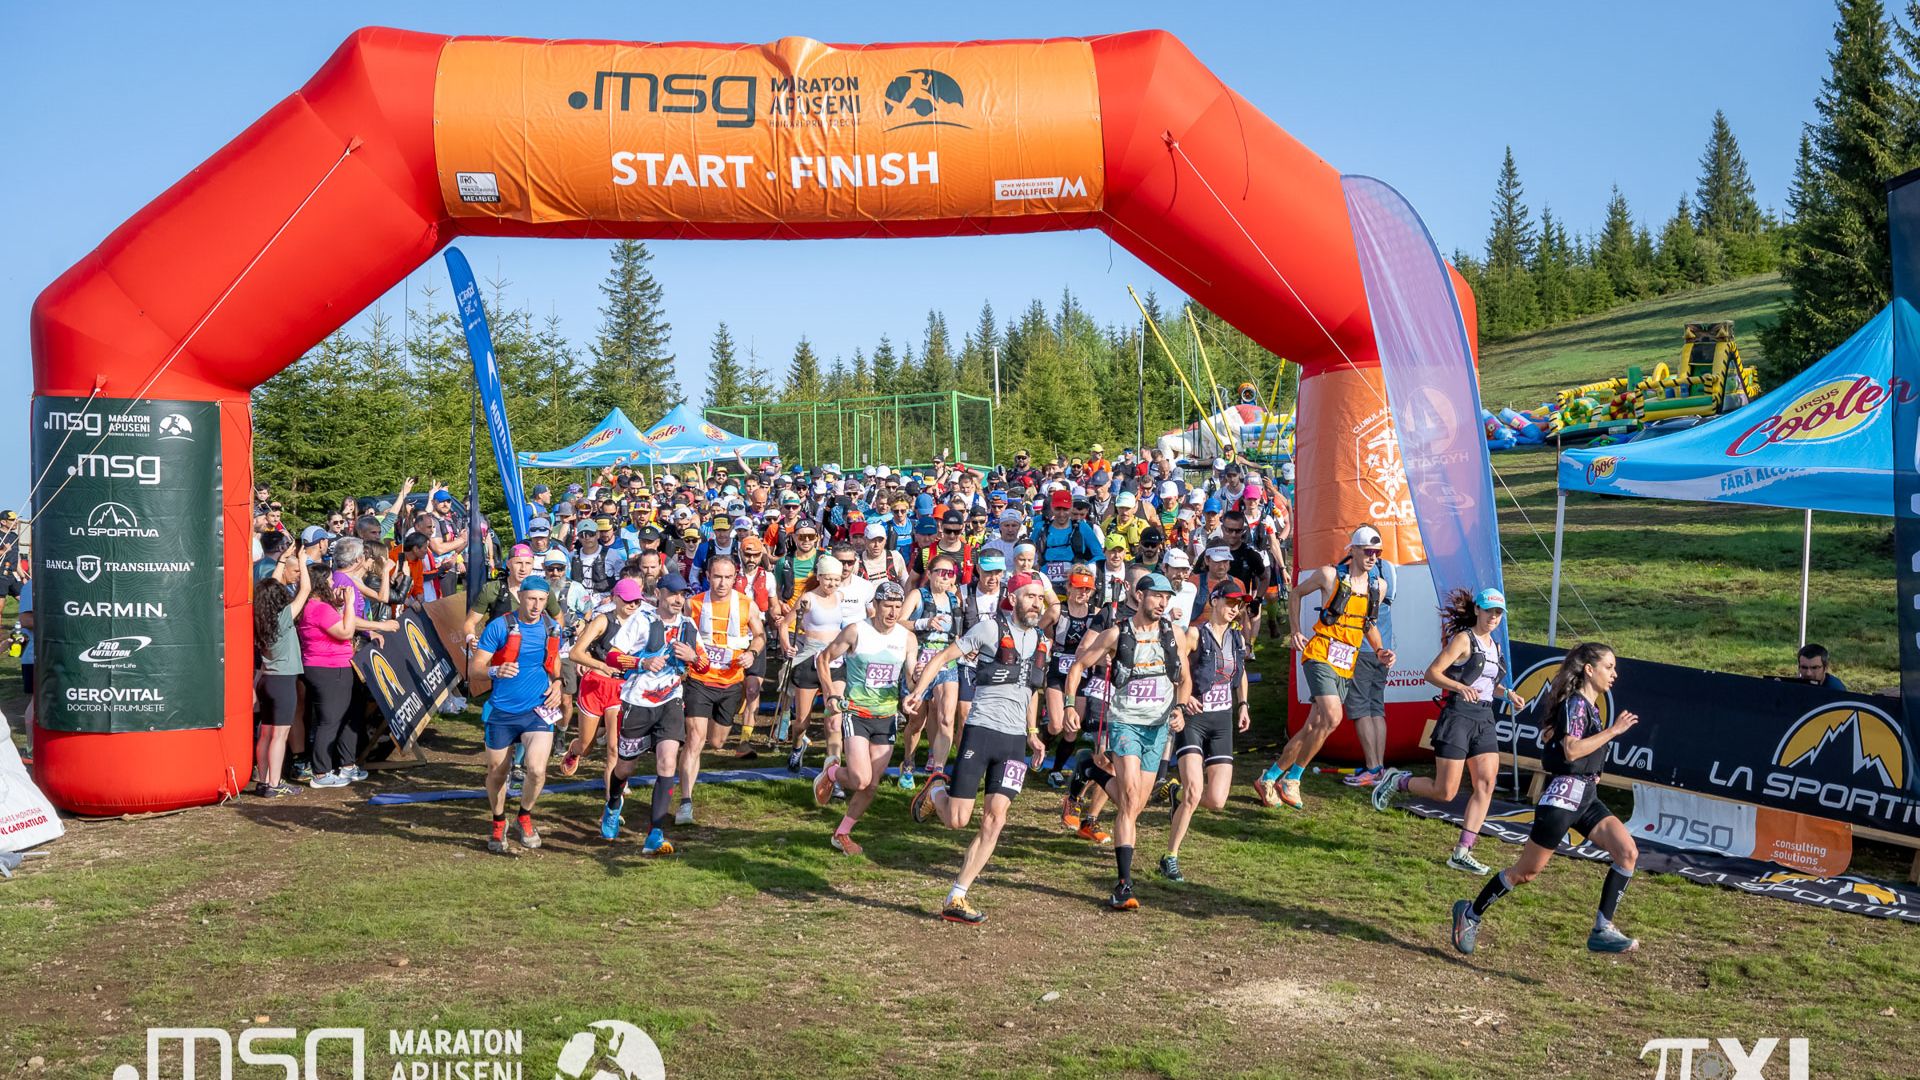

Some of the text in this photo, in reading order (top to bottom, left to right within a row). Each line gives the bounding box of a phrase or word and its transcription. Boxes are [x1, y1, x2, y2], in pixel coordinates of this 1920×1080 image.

[771, 76, 859, 93] MARATON
[567, 71, 757, 129] .msg
[770, 94, 861, 115] APUSENI
[612, 152, 939, 188] START FINISH
[1001, 187, 1054, 197] QUALIFIER
[1795, 388, 1839, 413] URSUS
[44, 412, 151, 436] .msg MARATON
[1725, 376, 1918, 456] Cooler
[108, 423, 151, 433] APUSENI
[67, 454, 161, 485] .msg
[1721, 469, 1753, 491] FĂRĂ
[69, 527, 159, 538] LA SPORTIVA
[46, 560, 74, 570] BANCA
[81, 561, 96, 571] BT
[1047, 566, 1062, 575] 651
[97, 641, 119, 650] PRO
[1330, 647, 1347, 660] 726
[427, 658, 452, 693] SPORTIVA
[868, 668, 891, 679] 632
[66, 687, 164, 703] GEROVITAL
[1130, 686, 1153, 696] 577
[1205, 691, 1227, 702] 673
[67, 704, 101, 712] DOCTOR
[389, 692, 424, 739] LA SPORTIVA
[1709, 761, 1753, 791] LA
[8, 815, 49, 834] CARPATILOR
